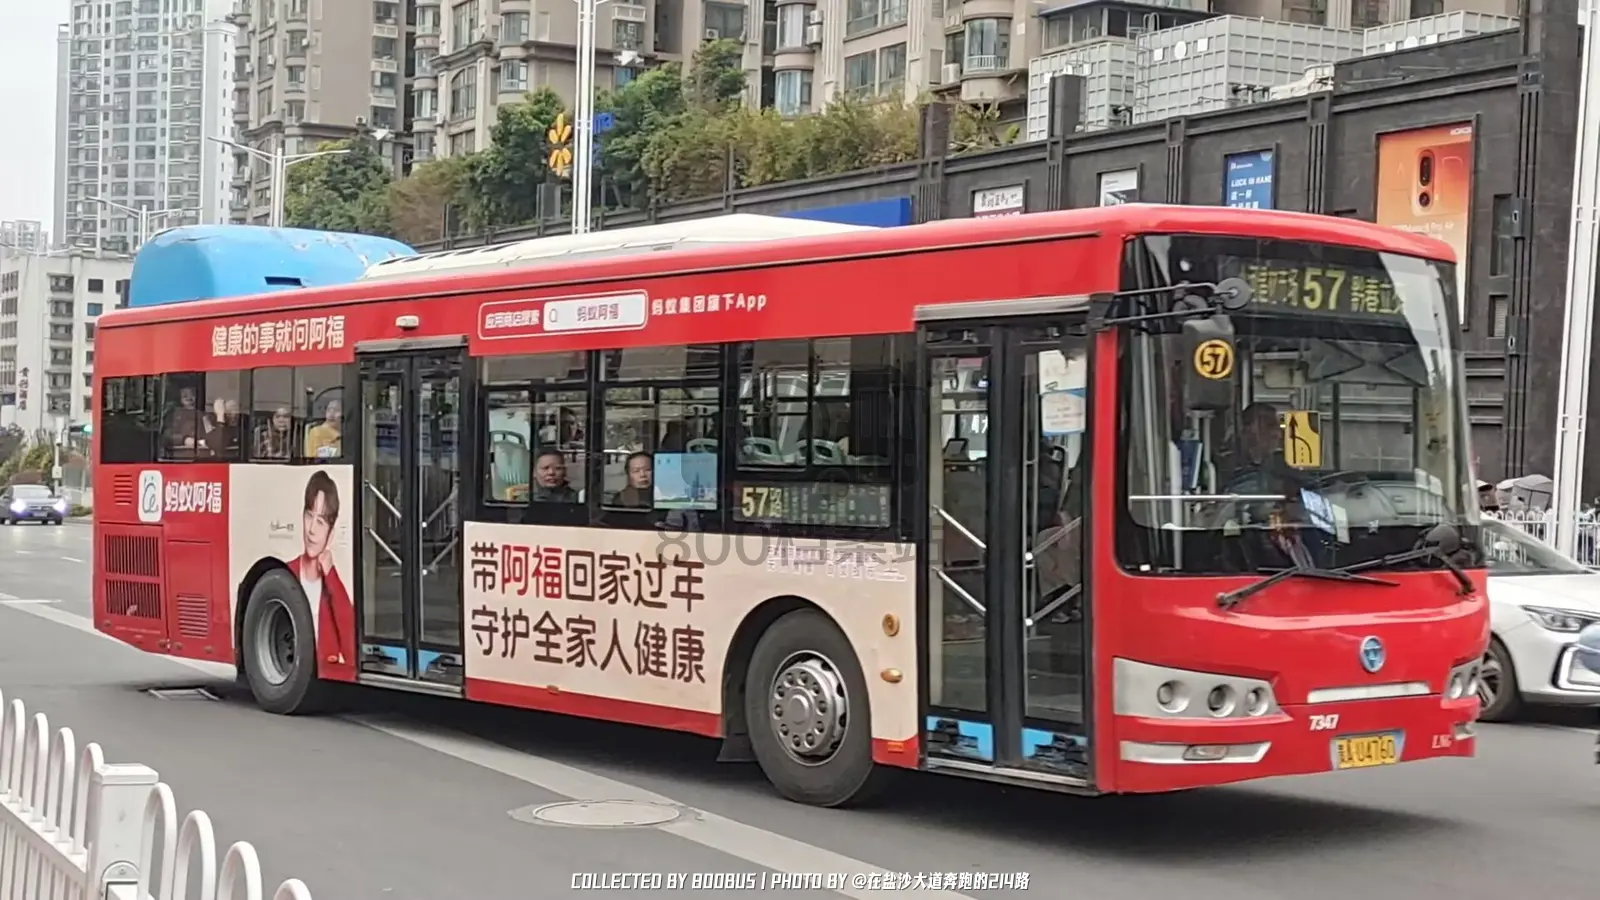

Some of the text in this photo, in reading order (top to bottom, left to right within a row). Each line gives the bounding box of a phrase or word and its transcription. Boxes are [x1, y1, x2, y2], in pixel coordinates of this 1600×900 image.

[1304, 268, 1346, 310] 57
[212, 315, 345, 356] 健康的事就问阿福
[1201, 345, 1227, 373] 57
[165, 481, 222, 513] 蚂蚁阿福
[470, 541, 706, 612] 带阿福回家过年
[470, 604, 706, 684] 守护全家人健康
[1309, 714, 1339, 731] 7347
